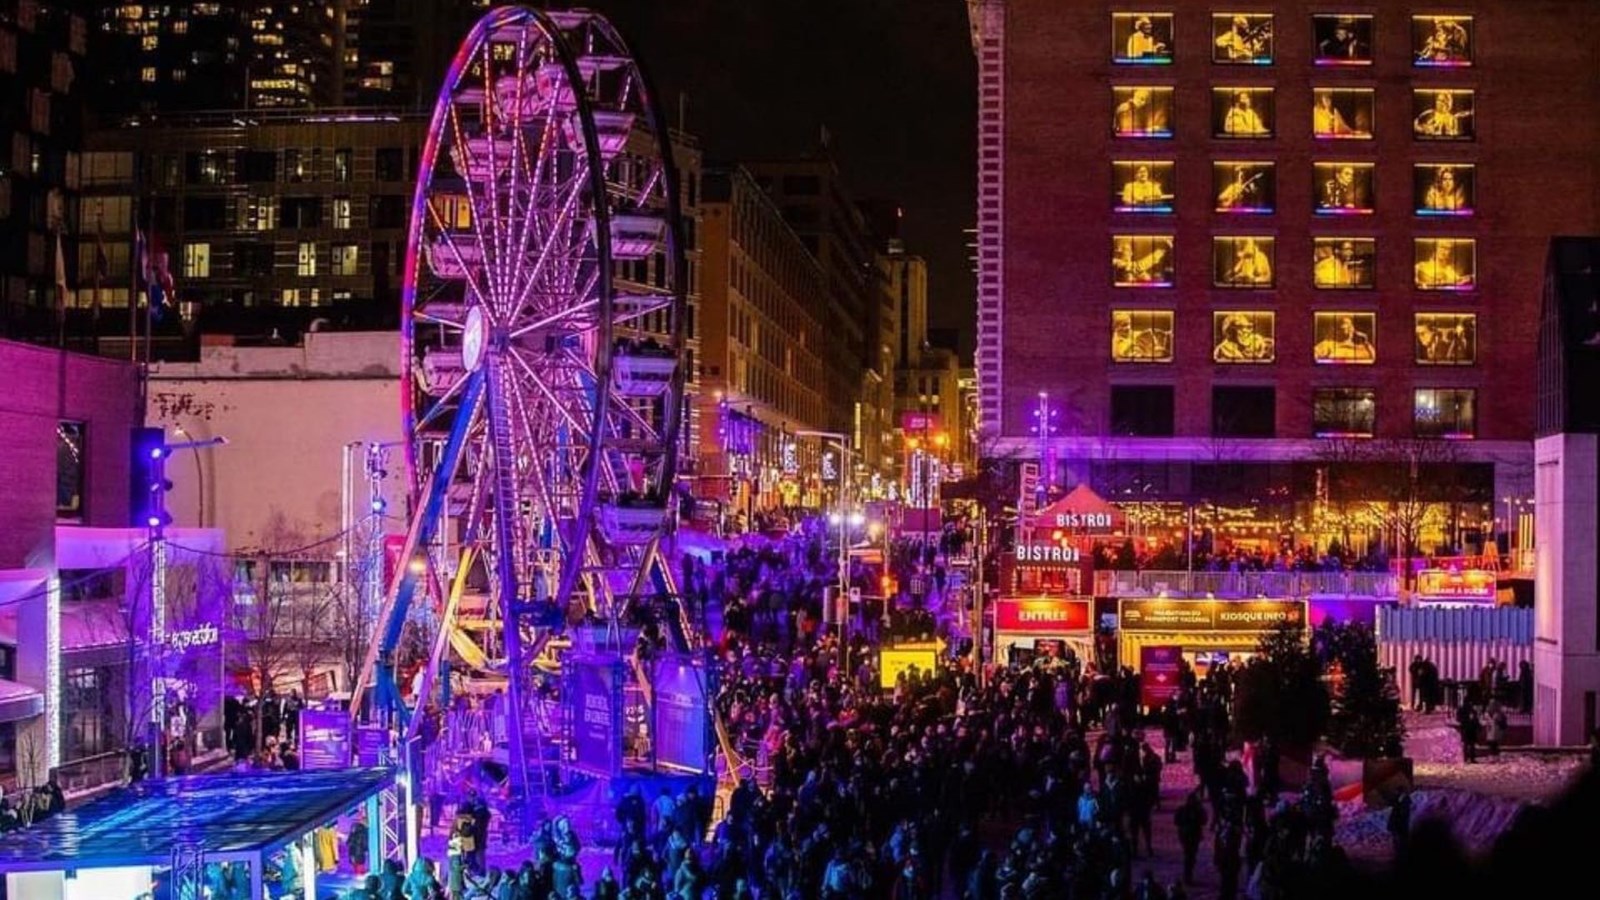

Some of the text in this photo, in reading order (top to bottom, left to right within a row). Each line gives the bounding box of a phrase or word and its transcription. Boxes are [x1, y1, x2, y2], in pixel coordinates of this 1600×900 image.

[1056, 513, 1105, 527] BISTRO
[1016, 545, 1072, 561] BISTRO
[1220, 611, 1262, 622] KIOSQUE
[1263, 611, 1287, 621] INFO
